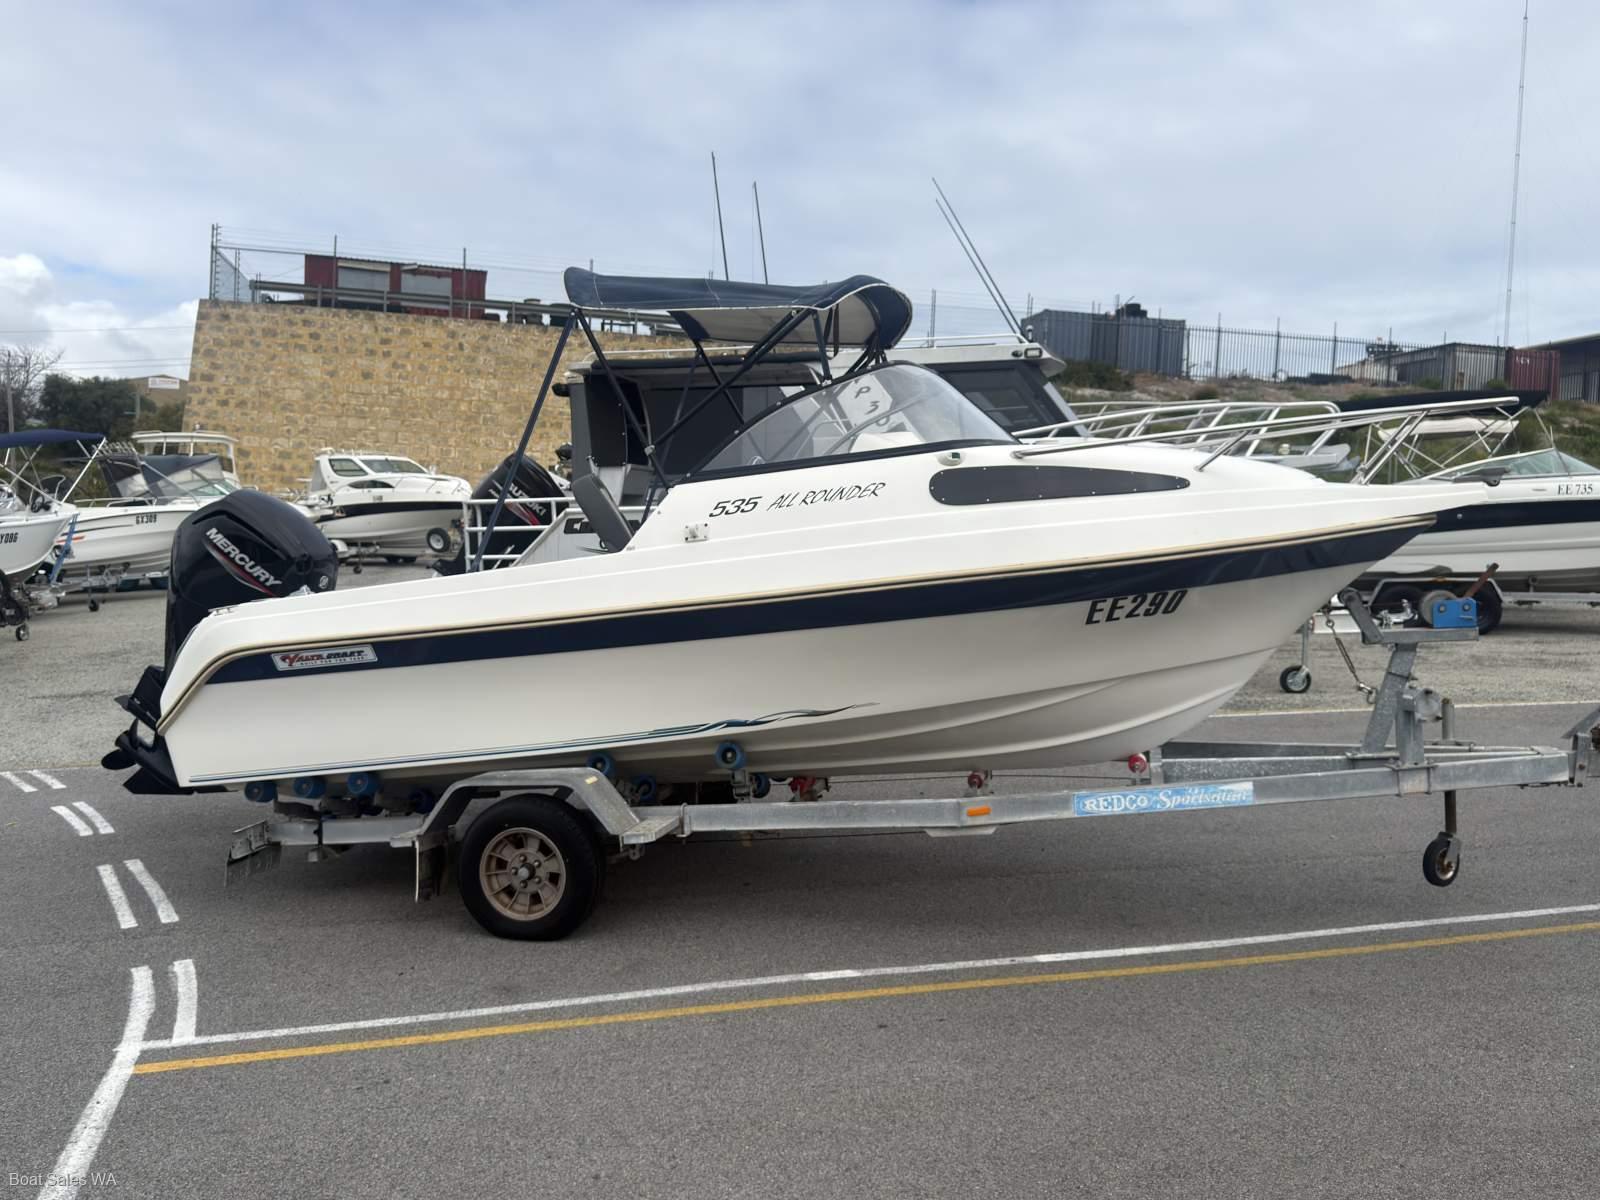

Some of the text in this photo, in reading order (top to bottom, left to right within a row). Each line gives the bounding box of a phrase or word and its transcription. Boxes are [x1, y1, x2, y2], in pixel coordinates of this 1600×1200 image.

[709, 482, 886, 518] 535 ALL ROUNDER
[1557, 483, 1593, 496] EE 735
[205, 527, 283, 587] MERCURY
[1085, 589, 1188, 625] EE290
